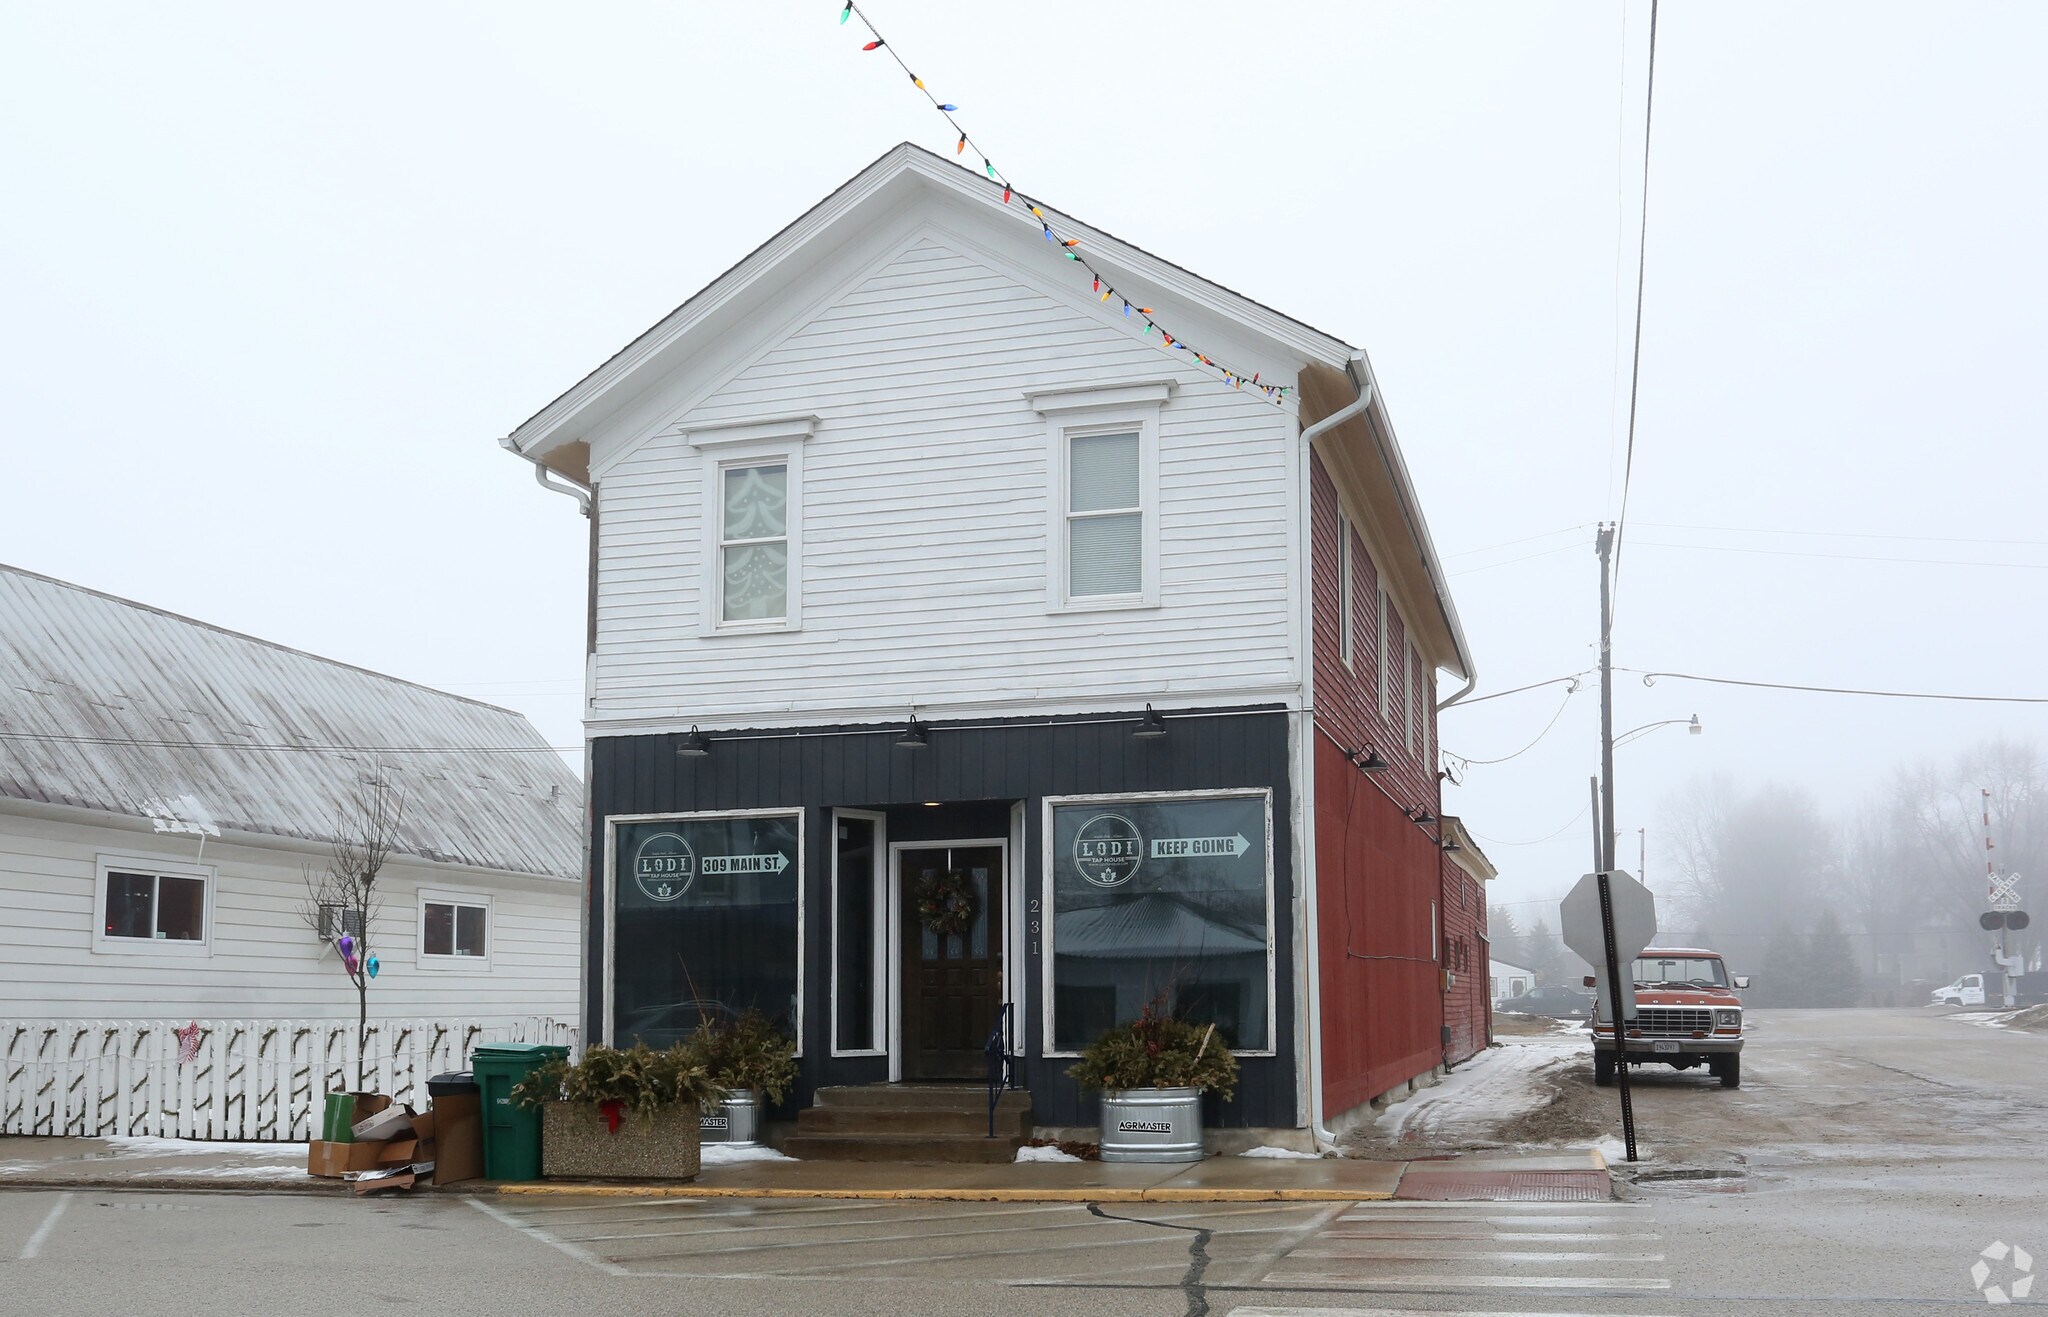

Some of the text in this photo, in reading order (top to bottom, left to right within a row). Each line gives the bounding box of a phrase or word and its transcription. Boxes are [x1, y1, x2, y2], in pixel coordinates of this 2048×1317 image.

[1082, 841, 1133, 857] LODI
[1157, 839, 1234, 855] KEEP GOING
[642, 858, 686, 872] LODI
[704, 857, 781, 872] 309 MAIN ST.
[1989, 873, 2020, 902] CROSSING
[700, 1118, 727, 1126] MASTER
